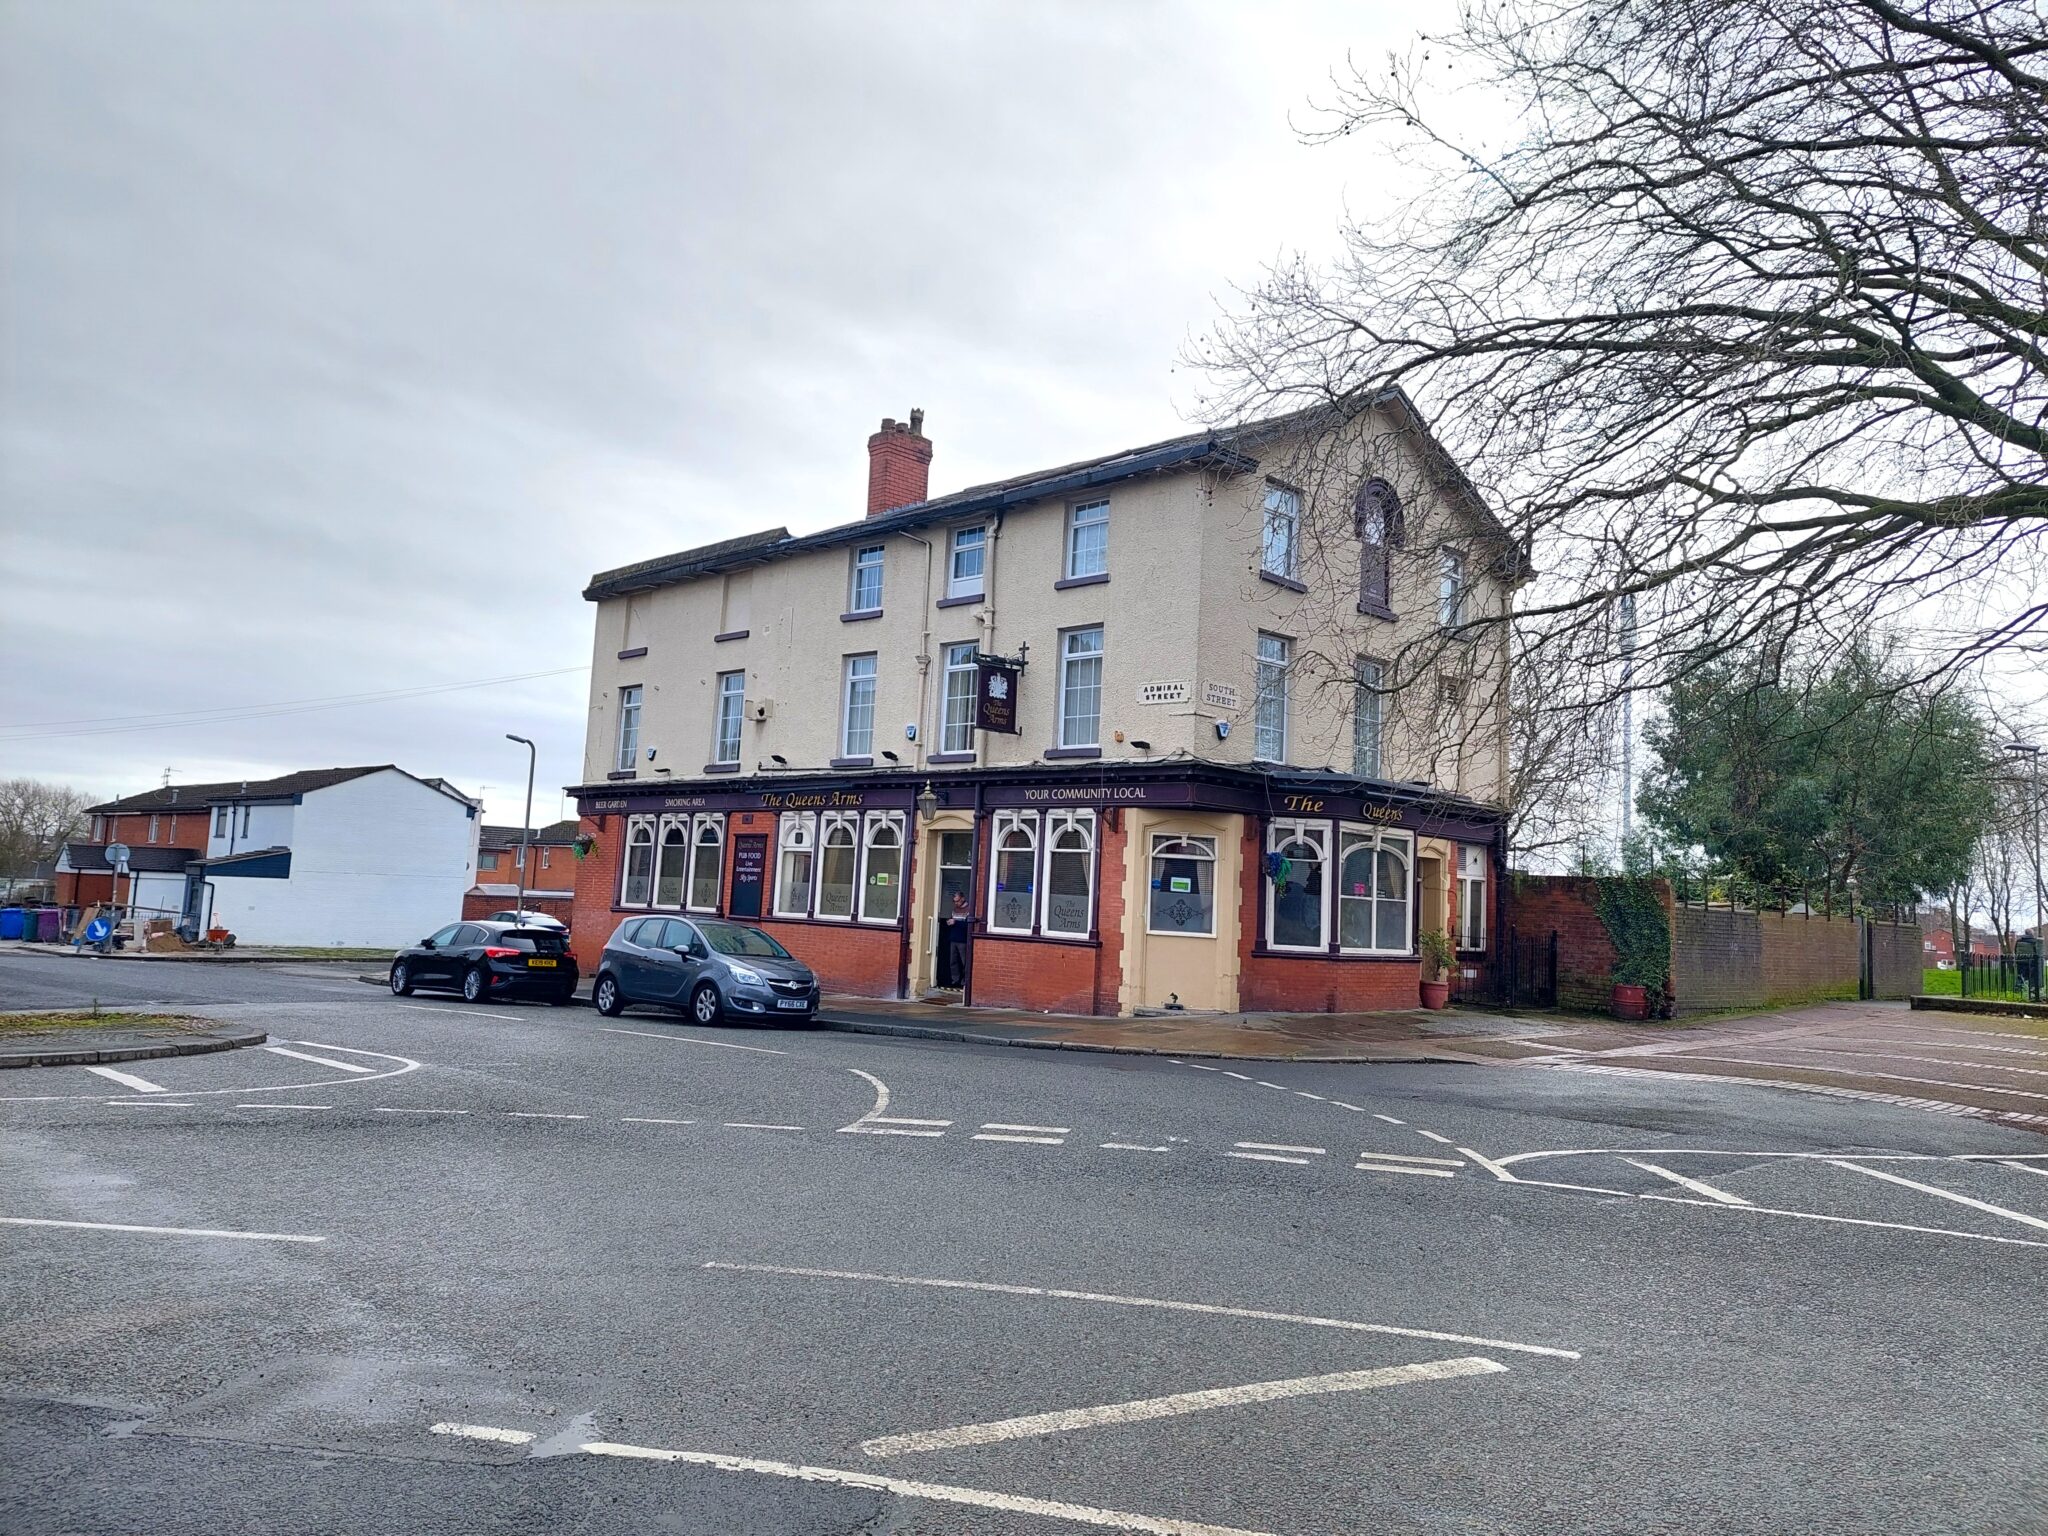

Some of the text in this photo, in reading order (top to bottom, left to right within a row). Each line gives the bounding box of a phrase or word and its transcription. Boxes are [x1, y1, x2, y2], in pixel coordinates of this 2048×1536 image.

[1143, 684, 1185, 693] ADMIRAL
[1209, 684, 1235, 696] SOUTH
[1145, 692, 1182, 701] STREET
[1206, 694, 1237, 707] STREET
[983, 703, 1010, 716] Queens
[987, 715, 1007, 725] Arms
[761, 791, 863, 808] The Queens Arms
[1025, 787, 1146, 800] YOUR COMMUNITY LOCAL
[595, 800, 628, 809] BEER GARDEN
[664, 797, 705, 807] SMOKING AREA
[1284, 795, 1403, 821] The Queens
[1054, 905, 1084, 918] Queens
[1058, 918, 1081, 929] Arms
